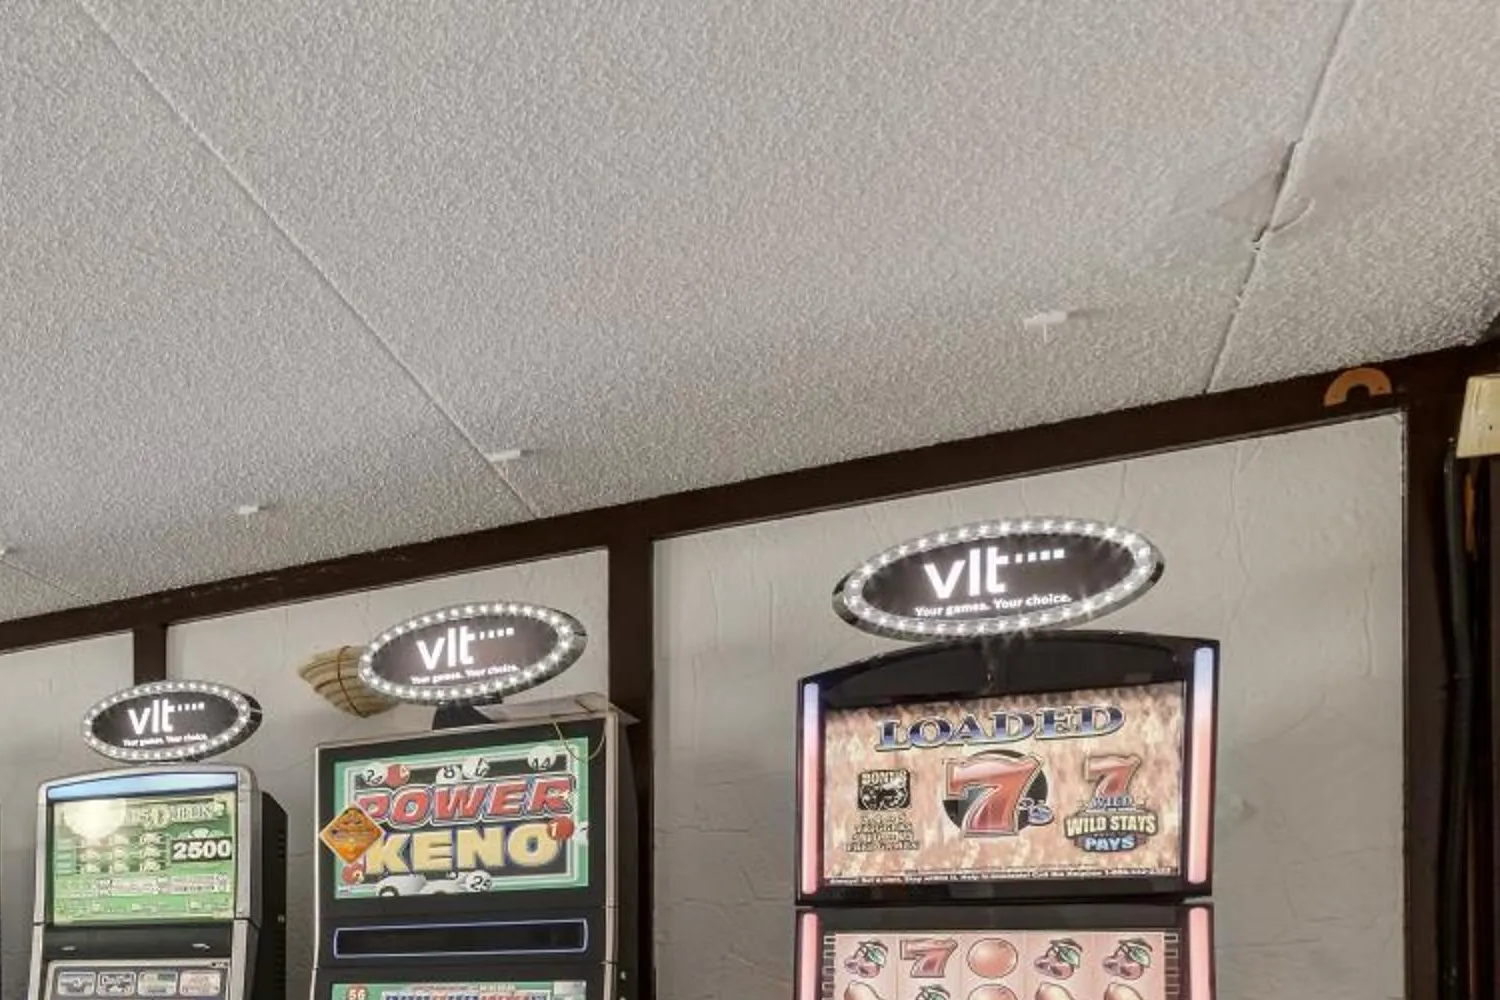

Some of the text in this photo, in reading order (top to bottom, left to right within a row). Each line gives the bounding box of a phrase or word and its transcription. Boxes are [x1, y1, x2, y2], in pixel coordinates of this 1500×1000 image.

[924, 547, 1008, 599] vlt
[915, 606, 942, 617] Your
[994, 598, 1022, 609] Your
[416, 626, 475, 670] vlt
[128, 699, 175, 735] vlt
[876, 706, 1124, 752] LOADED
[355, 776, 576, 826] POWER
[1066, 811, 1158, 838] WILD STAYS
[1085, 836, 1136, 850] PAYS
[364, 823, 560, 875] KENO
